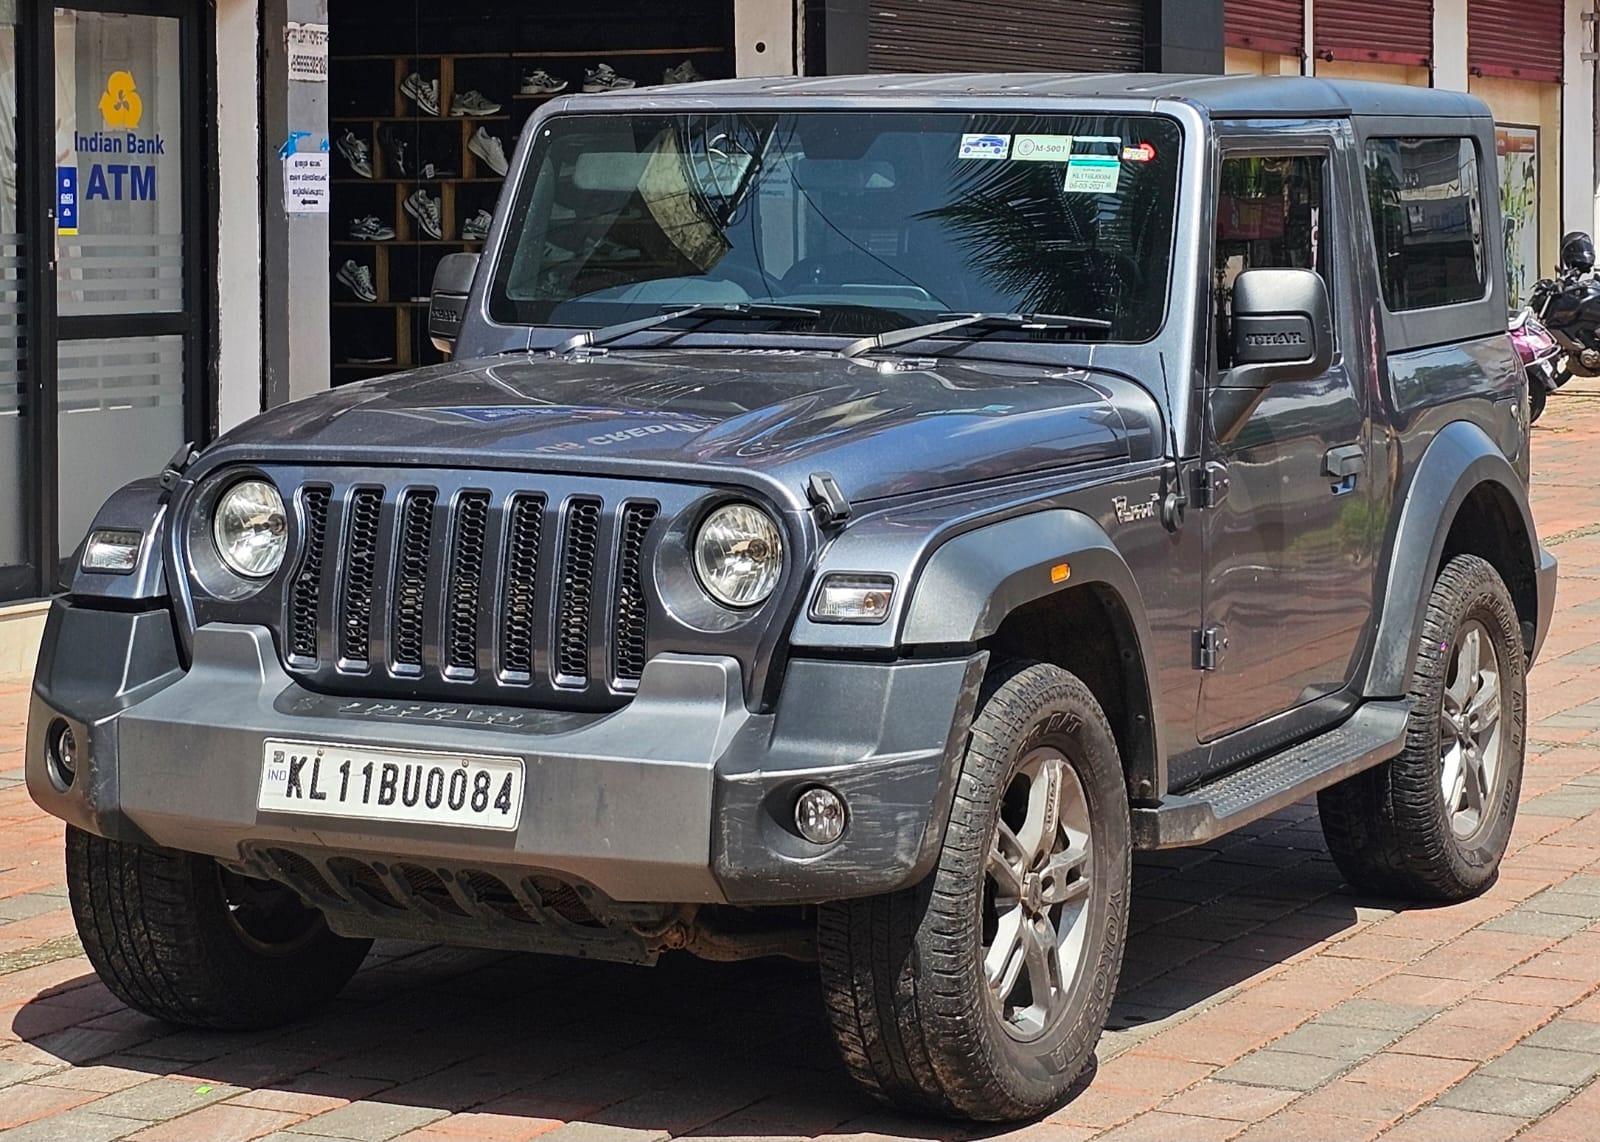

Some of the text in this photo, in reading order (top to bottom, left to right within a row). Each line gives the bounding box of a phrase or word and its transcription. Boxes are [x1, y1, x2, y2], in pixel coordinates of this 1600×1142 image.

[74, 130, 164, 155] Indian Bank
[86, 164, 156, 201] ATM
[1245, 332, 1306, 346] THAR
[267, 768, 287, 783] IND
[285, 755, 514, 815] KL11BU0084
